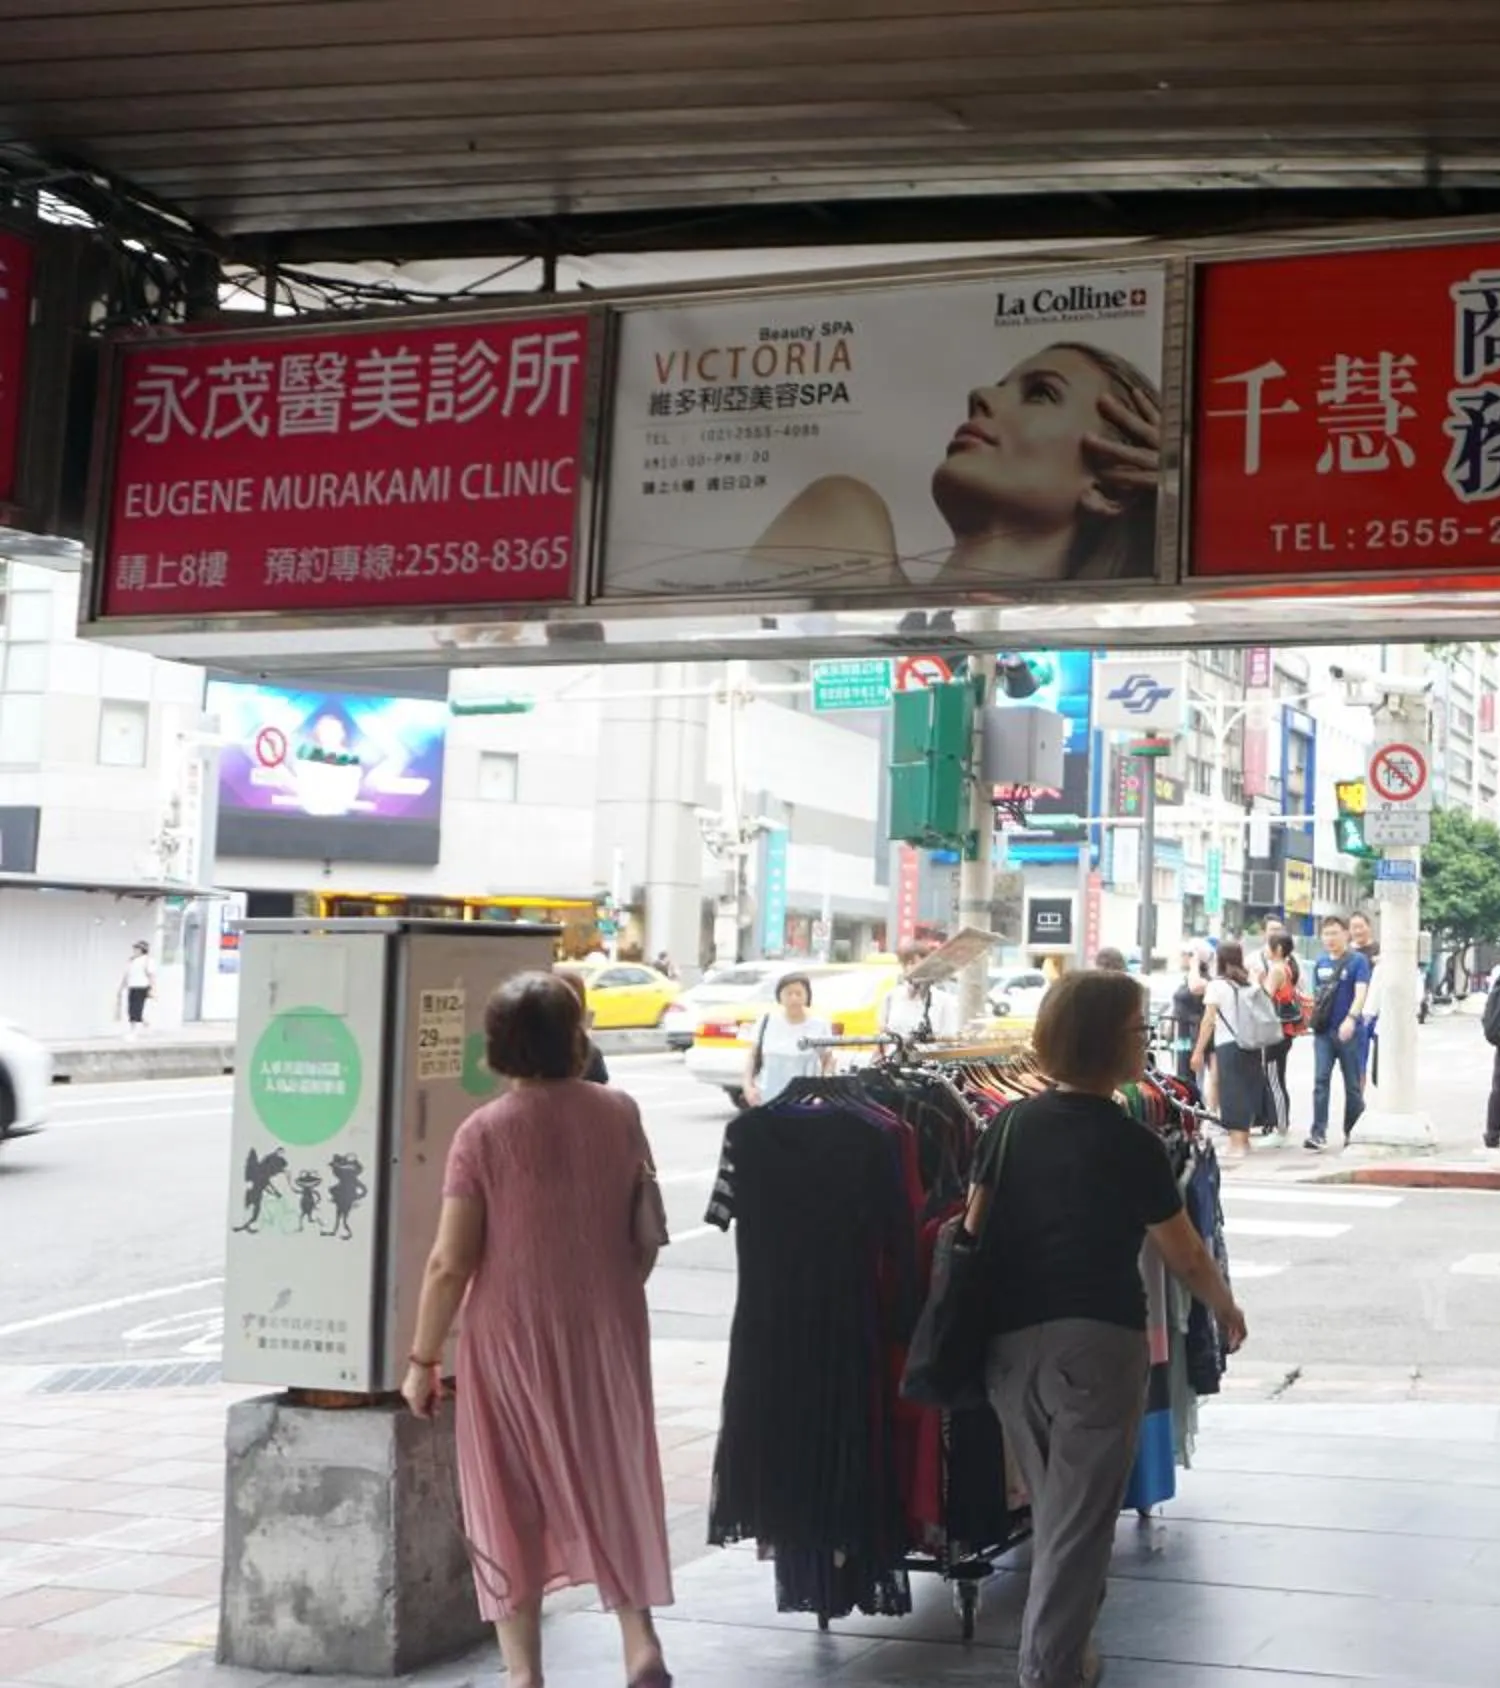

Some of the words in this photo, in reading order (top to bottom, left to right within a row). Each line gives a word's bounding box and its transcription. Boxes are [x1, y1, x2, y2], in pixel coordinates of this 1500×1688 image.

[995, 292, 1025, 317] La
[1033, 285, 1126, 313] Colline
[759, 325, 815, 344] Beauty
[821, 321, 854, 338] SPA
[654, 339, 852, 384] VICTORIA
[130, 331, 580, 444] 永茂醫美診所
[648, 380, 849, 416] 維多利亞美容SPA
[1207, 352, 1419, 475] 千慧
[125, 478, 252, 518] EUGENE
[261, 466, 451, 512] MURAKAMI
[460, 457, 575, 499] CLINIC
[115, 550, 228, 591] 請上8樓
